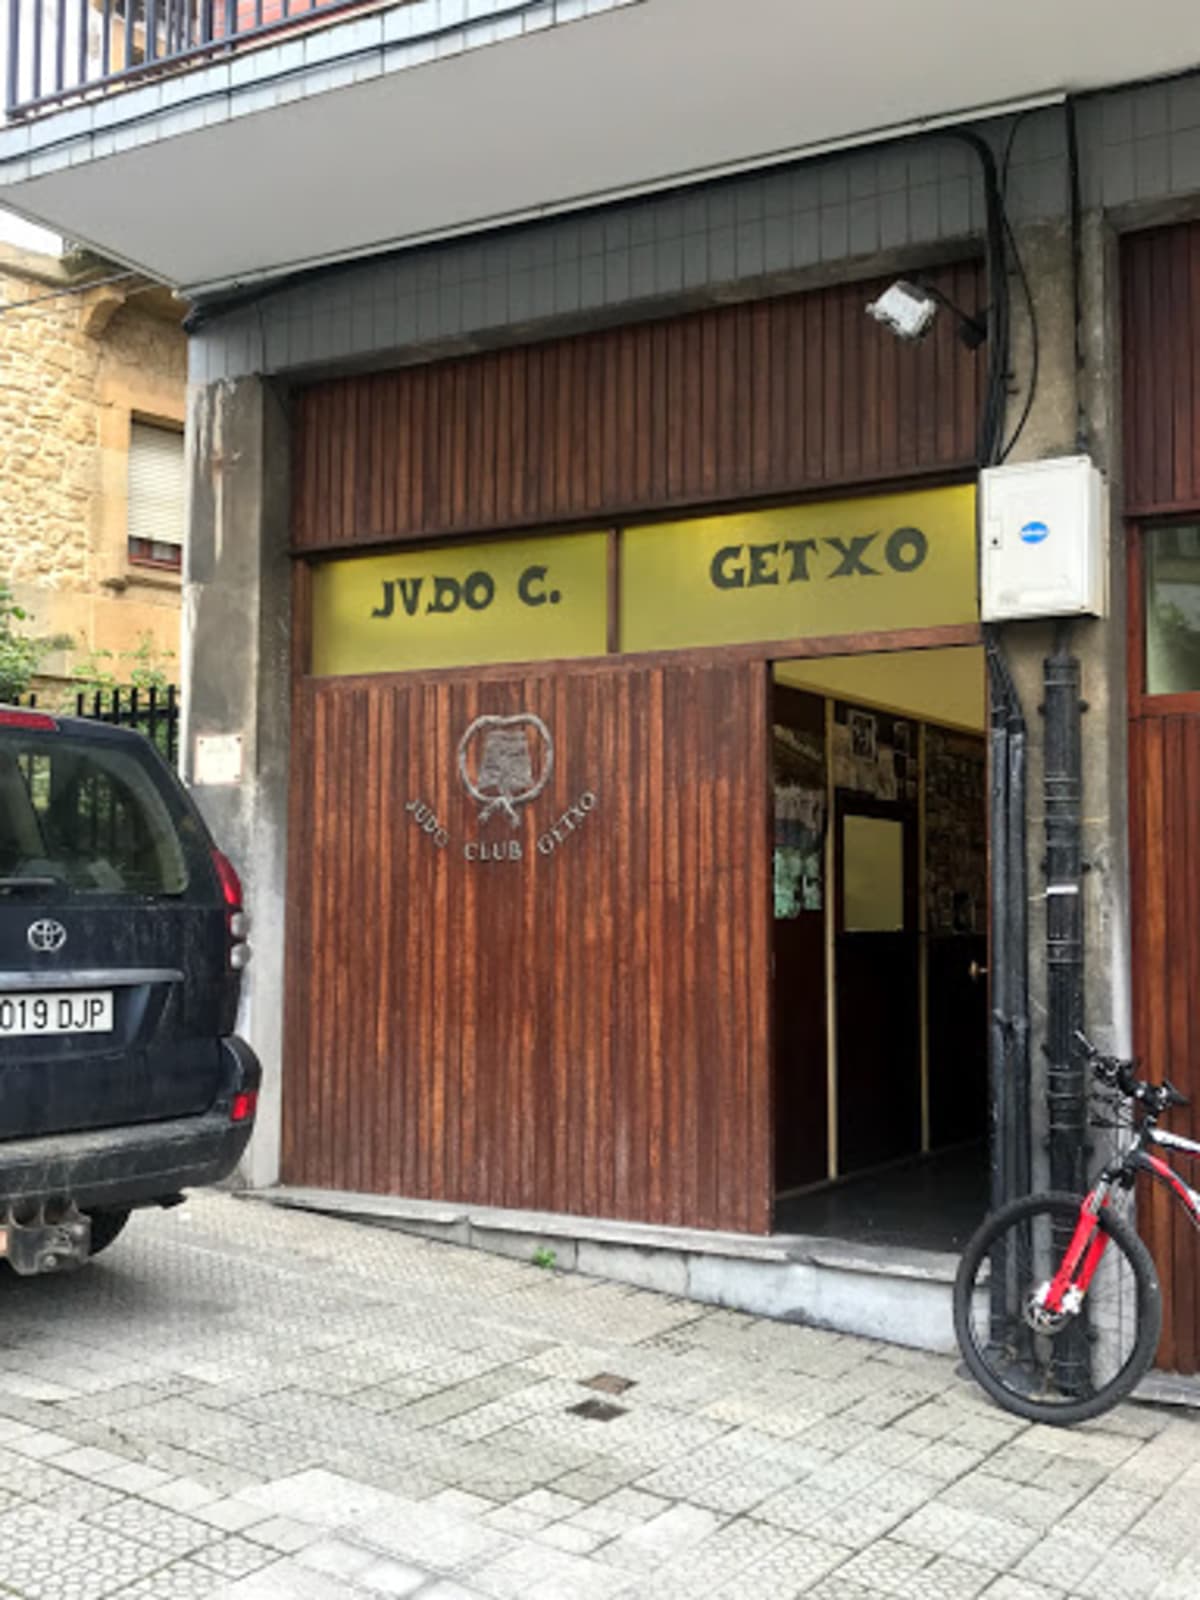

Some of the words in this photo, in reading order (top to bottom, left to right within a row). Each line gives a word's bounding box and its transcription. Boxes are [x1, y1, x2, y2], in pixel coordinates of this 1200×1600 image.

[517, 564, 562, 607] C.
[709, 526, 929, 590] GETXO
[405, 799, 450, 848] JUDO
[464, 841, 523, 862] CLUB
[58, 997, 105, 1029] DJP
